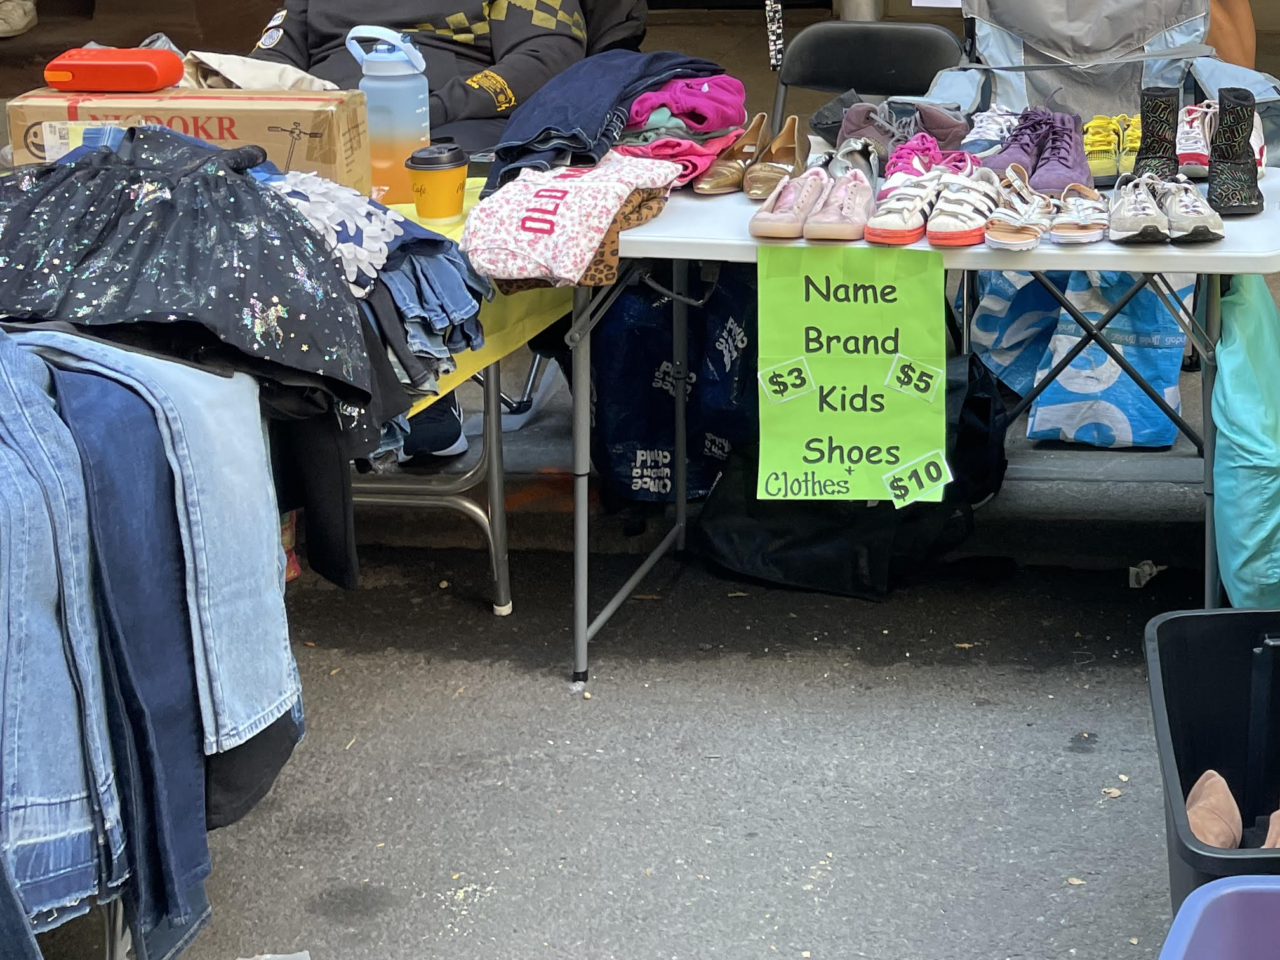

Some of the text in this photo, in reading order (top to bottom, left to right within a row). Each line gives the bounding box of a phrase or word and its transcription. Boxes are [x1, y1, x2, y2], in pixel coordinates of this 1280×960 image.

[520, 188, 569, 235] OLD
[804, 275, 898, 304] Name
[804, 326, 899, 355] Brand
[768, 367, 807, 397] $3
[895, 363, 934, 394] $5
[818, 385, 885, 413] Kids
[802, 436, 900, 466] Shoes
[765, 471, 850, 498] Clothes
[888, 460, 943, 502] $10
